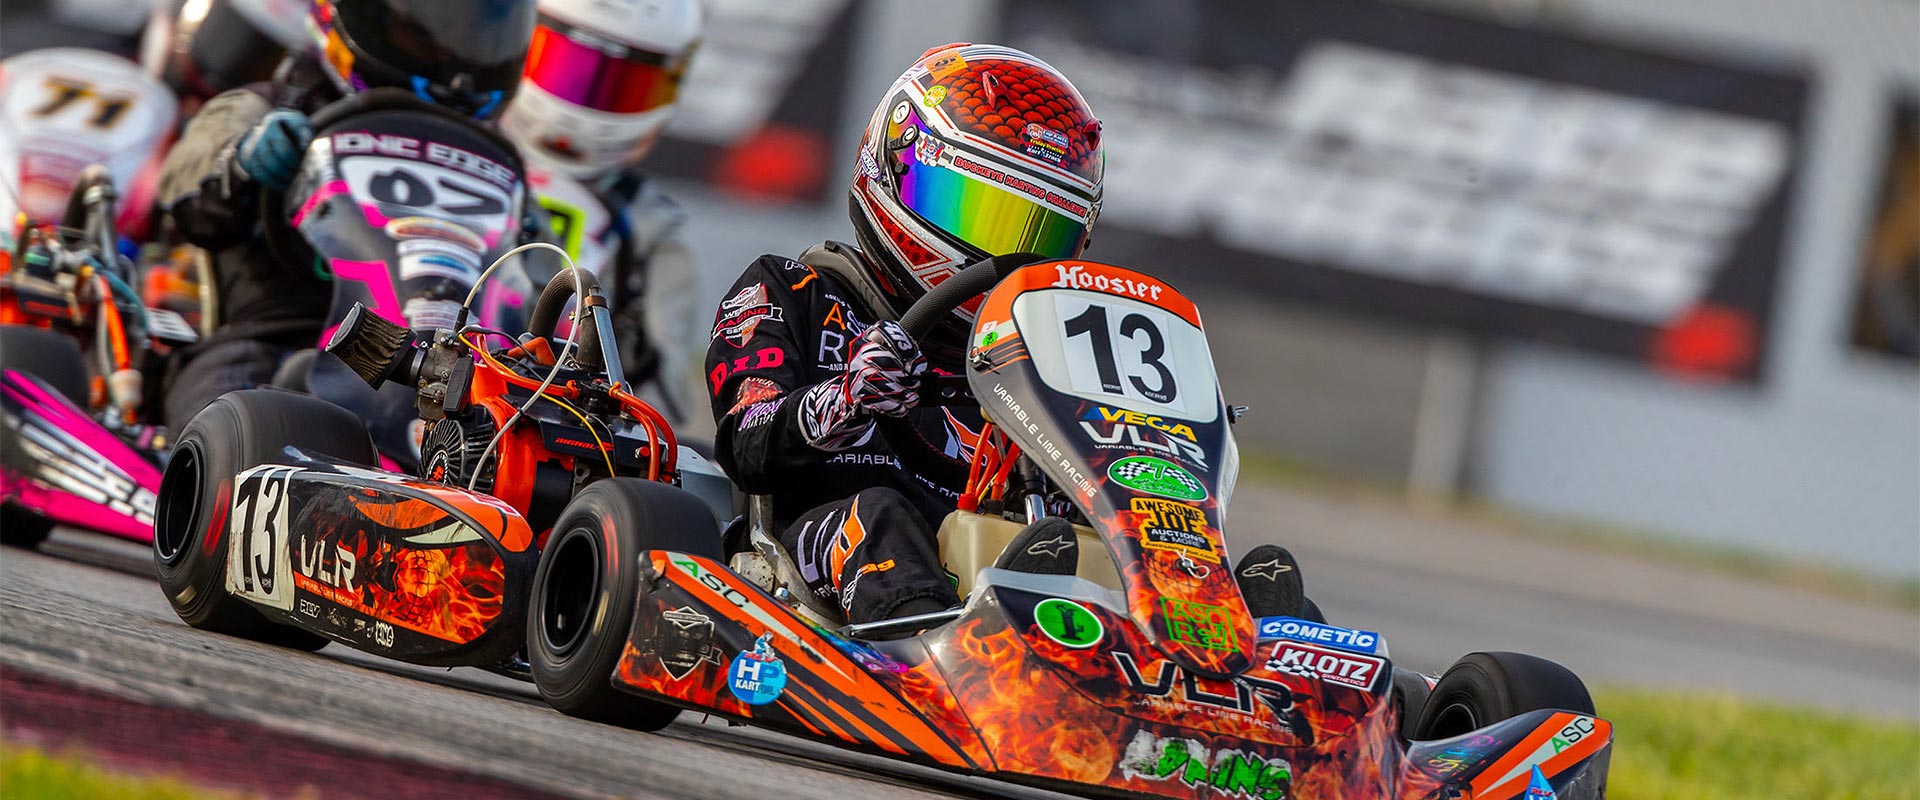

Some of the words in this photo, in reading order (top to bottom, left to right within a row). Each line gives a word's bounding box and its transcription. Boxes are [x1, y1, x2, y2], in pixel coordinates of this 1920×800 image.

[954, 156, 1004, 183] BUCKEYE
[1004, 174, 1046, 200] KARTING
[1051, 263, 1163, 301] Hoosier
[717, 308, 768, 331] RACING
[724, 298, 759, 318] WEEKLY
[1064, 304, 1177, 404] 13
[1098, 407, 1198, 443] VEGA
[993, 383, 1038, 435] VARIABLE
[1036, 433, 1062, 461] LINE
[1059, 458, 1098, 498] RACING
[1094, 443, 1147, 453] VARIABLE
[1136, 500, 1200, 520] AWESOME
[1148, 509, 1201, 535] JOE
[236, 467, 292, 595] 13
[1151, 528, 1206, 544] AUCTIONS
[673, 560, 750, 608] ASC
[1173, 604, 1224, 627] ASC
[1262, 621, 1375, 647] COMETIC
[737, 659, 780, 682] HP
[1280, 648, 1373, 681] KLOTZ
[1321, 673, 1366, 688] SYNTHETICS
[1207, 707, 1240, 722] LINE
[1243, 715, 1294, 735] RACING
[1551, 717, 1596, 754] ASC
